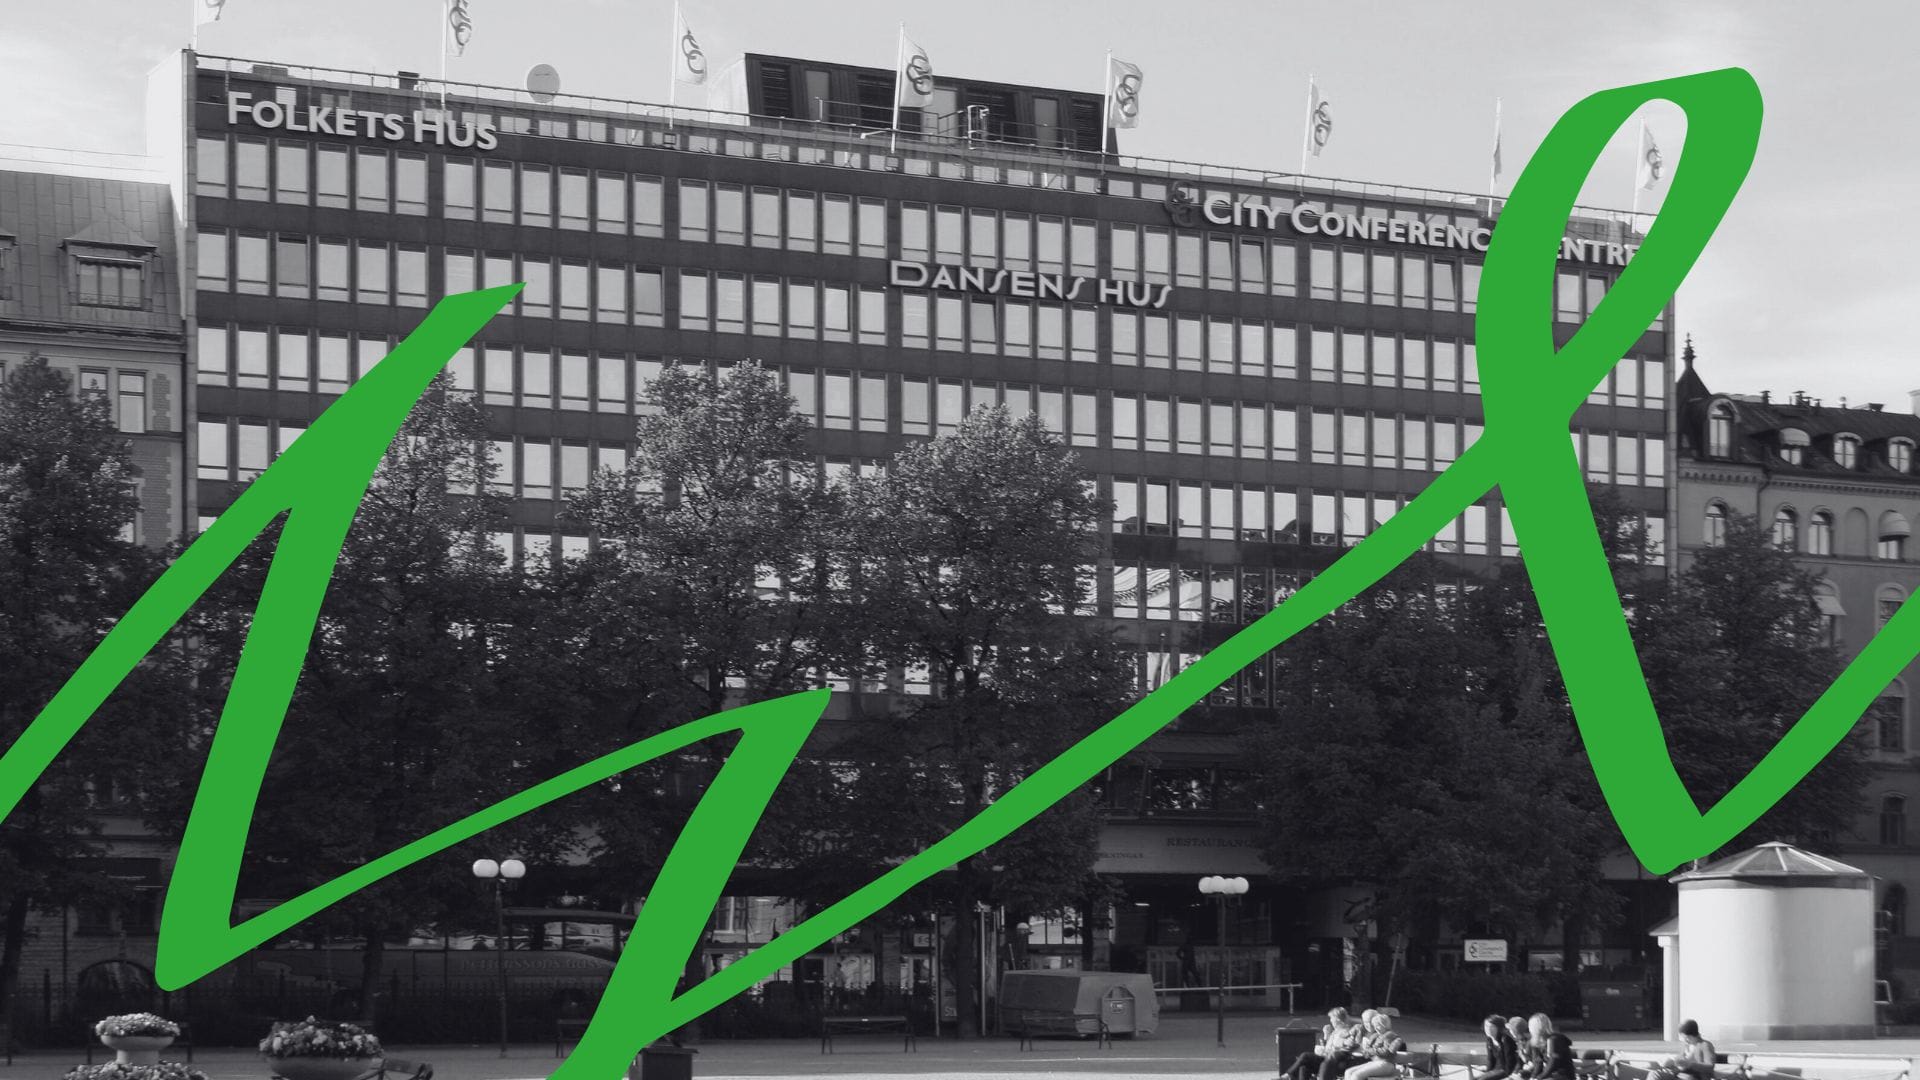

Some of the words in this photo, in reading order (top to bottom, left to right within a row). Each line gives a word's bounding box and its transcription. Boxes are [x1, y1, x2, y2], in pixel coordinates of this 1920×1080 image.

[228, 91, 404, 140] FOLKETS
[413, 110, 498, 150] HUS
[1203, 194, 1282, 229] CITY
[1291, 203, 1491, 252] CONFERENC
[890, 259, 1086, 300] DANSENS
[1099, 278, 1172, 309] HUS
